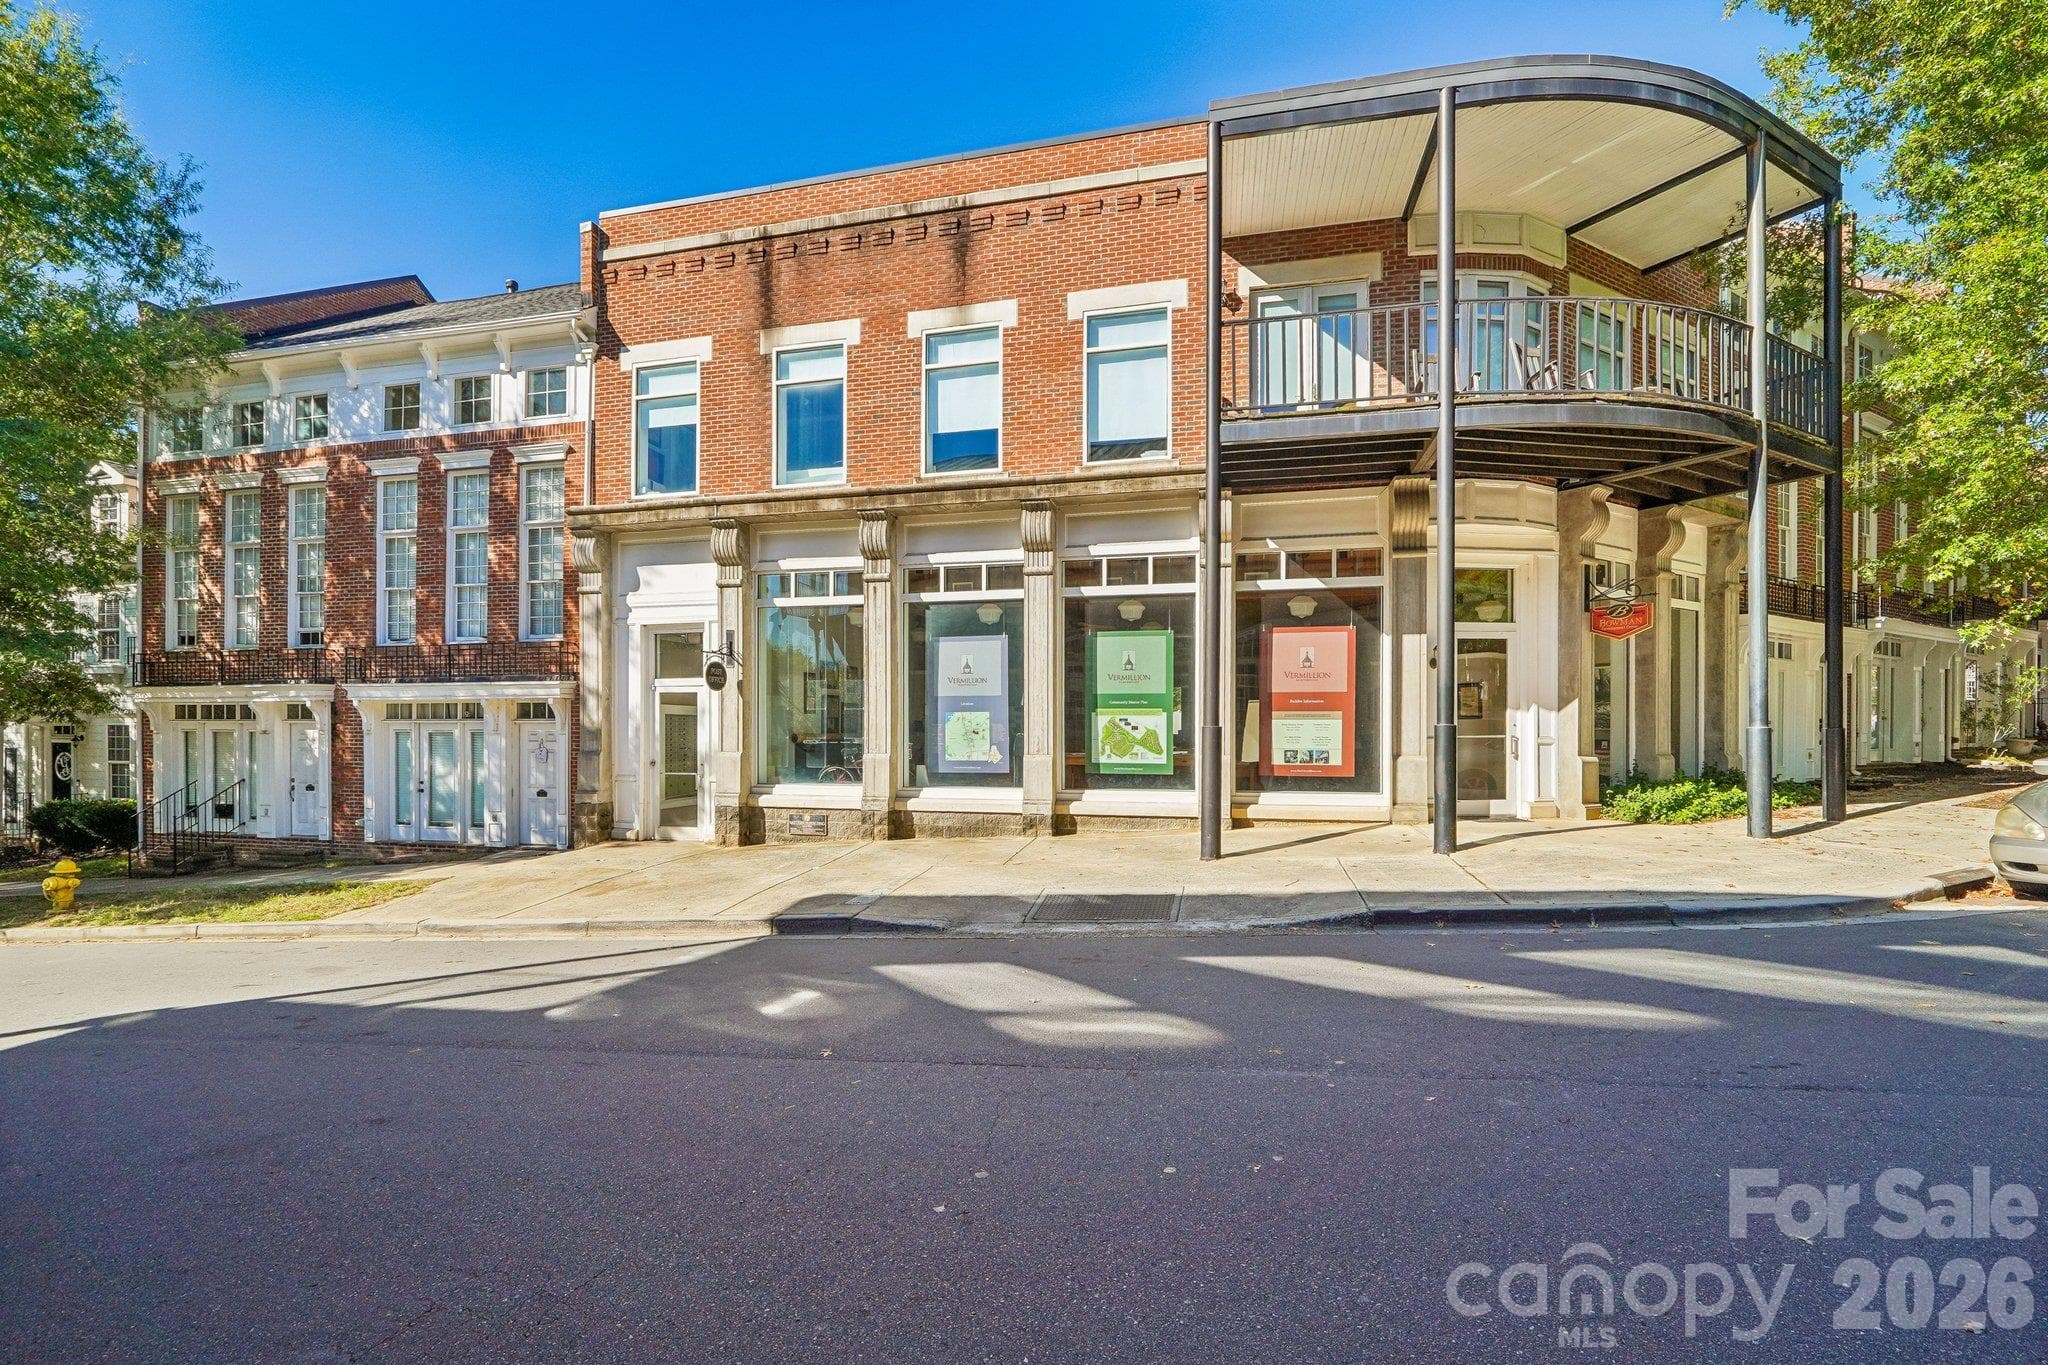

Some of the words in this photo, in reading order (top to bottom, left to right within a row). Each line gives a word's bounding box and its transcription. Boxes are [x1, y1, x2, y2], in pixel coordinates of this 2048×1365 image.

[1107, 673, 1151, 681] VERMILLION
[1284, 671, 1332, 679] VERMILLION
[947, 676, 988, 684] VERMILLION
